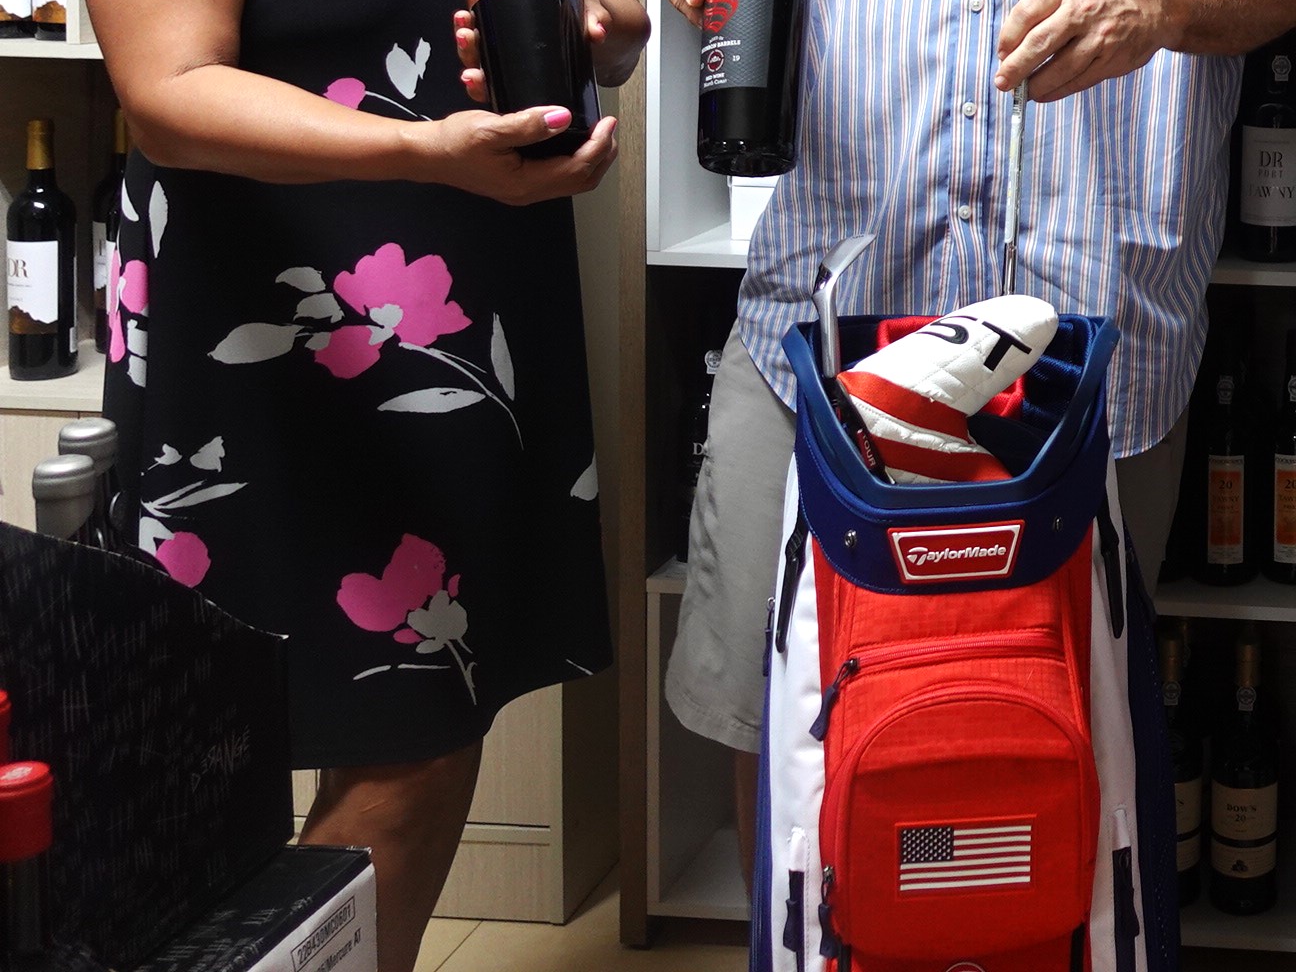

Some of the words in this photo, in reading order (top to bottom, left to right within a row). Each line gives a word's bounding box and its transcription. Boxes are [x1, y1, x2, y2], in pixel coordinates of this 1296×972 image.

[1260, 150, 1283, 168] DR
[1258, 170, 1284, 179] PORT
[1249, 185, 1295, 199] TAWNY
[862, 432, 877, 468] TOUR
[1218, 479, 1233, 490] 20
[906, 545, 1007, 566] TaylorMade
[1226, 803, 1257, 813] DOW'S
[1235, 814, 1247, 823] 20
